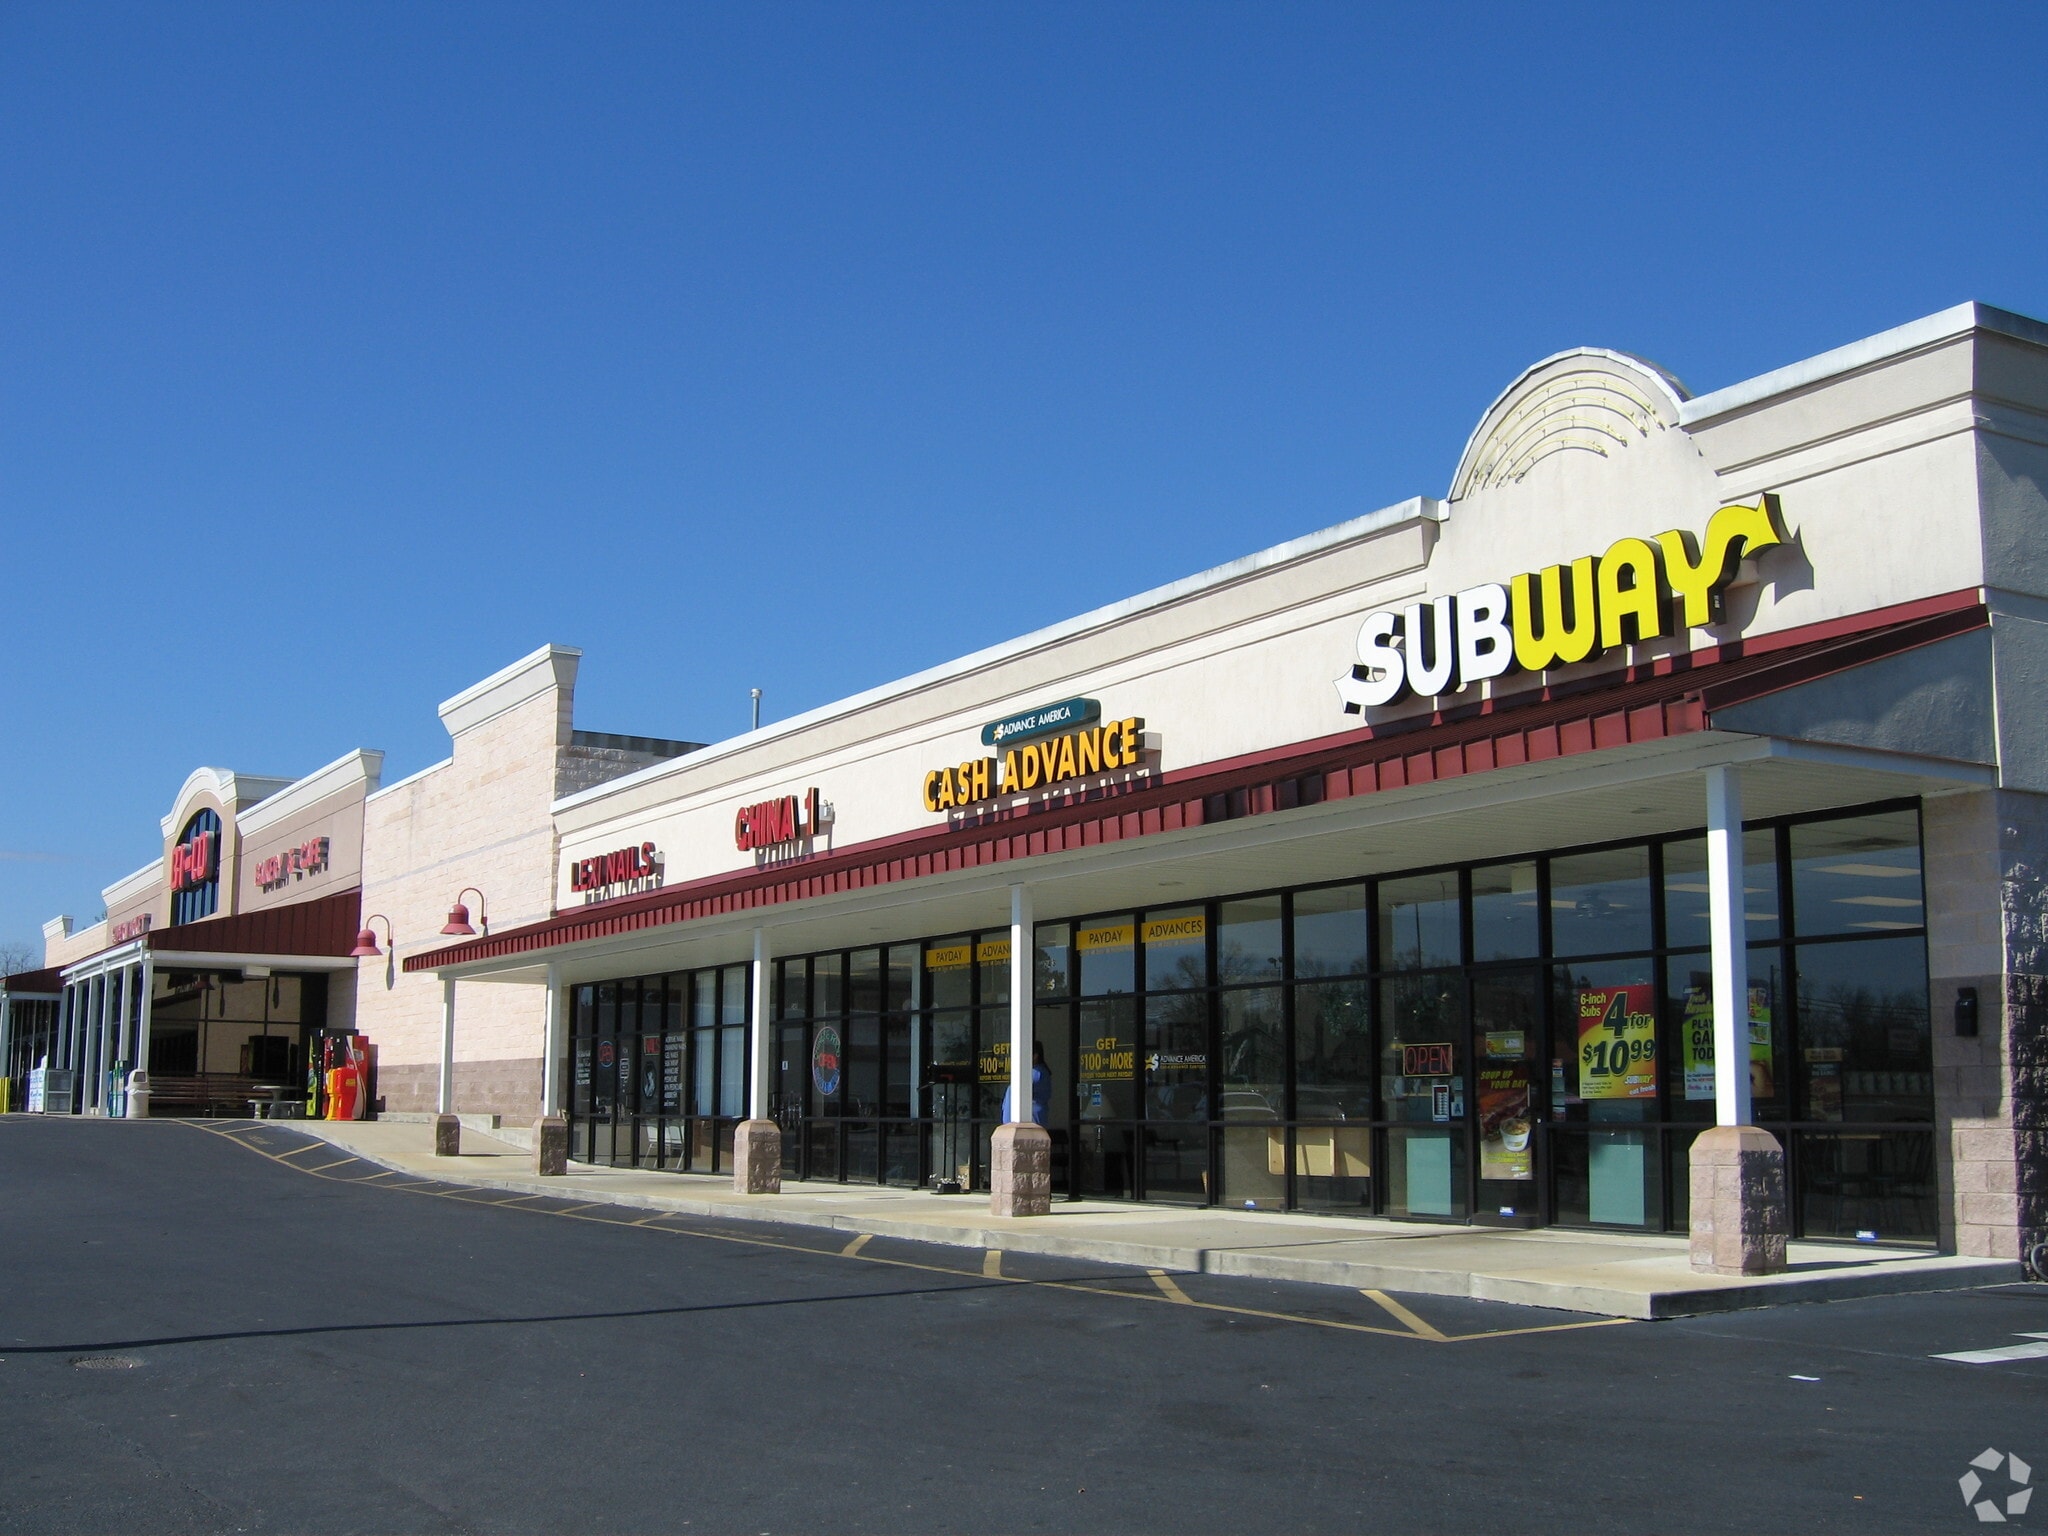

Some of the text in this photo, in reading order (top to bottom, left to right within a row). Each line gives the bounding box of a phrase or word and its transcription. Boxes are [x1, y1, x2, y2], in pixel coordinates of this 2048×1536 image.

[1333, 492, 1781, 712] SUBWAY
[1004, 706, 1071, 736] ADVANCE AMERICA
[923, 717, 1139, 812] CASH ADVANCE
[735, 787, 818, 851] CHINA 1
[170, 831, 211, 891] BI-LO
[571, 842, 655, 892] LEXI NAILS
[1089, 919, 1203, 944] PAYDAY ADVANCES
[936, 943, 1010, 963] PAYDAY ADVAN
[1580, 993, 1607, 1005] 6-inch
[1580, 1005, 1601, 1018] Subs
[1602, 991, 1652, 1039] 4 for
[993, 1043, 1010, 1054] GET
[1096, 1038, 1117, 1050] GET
[1692, 1047, 1715, 1060] TOD
[979, 1057, 998, 1073] $100
[1080, 1052, 1102, 1070] $100
[1110, 1052, 1133, 1069] MORE
[1405, 1046, 1449, 1074] OPEN
[1480, 1070, 1514, 1080] SOUP UP
[1491, 1079, 1527, 1089] YOUR DAY
